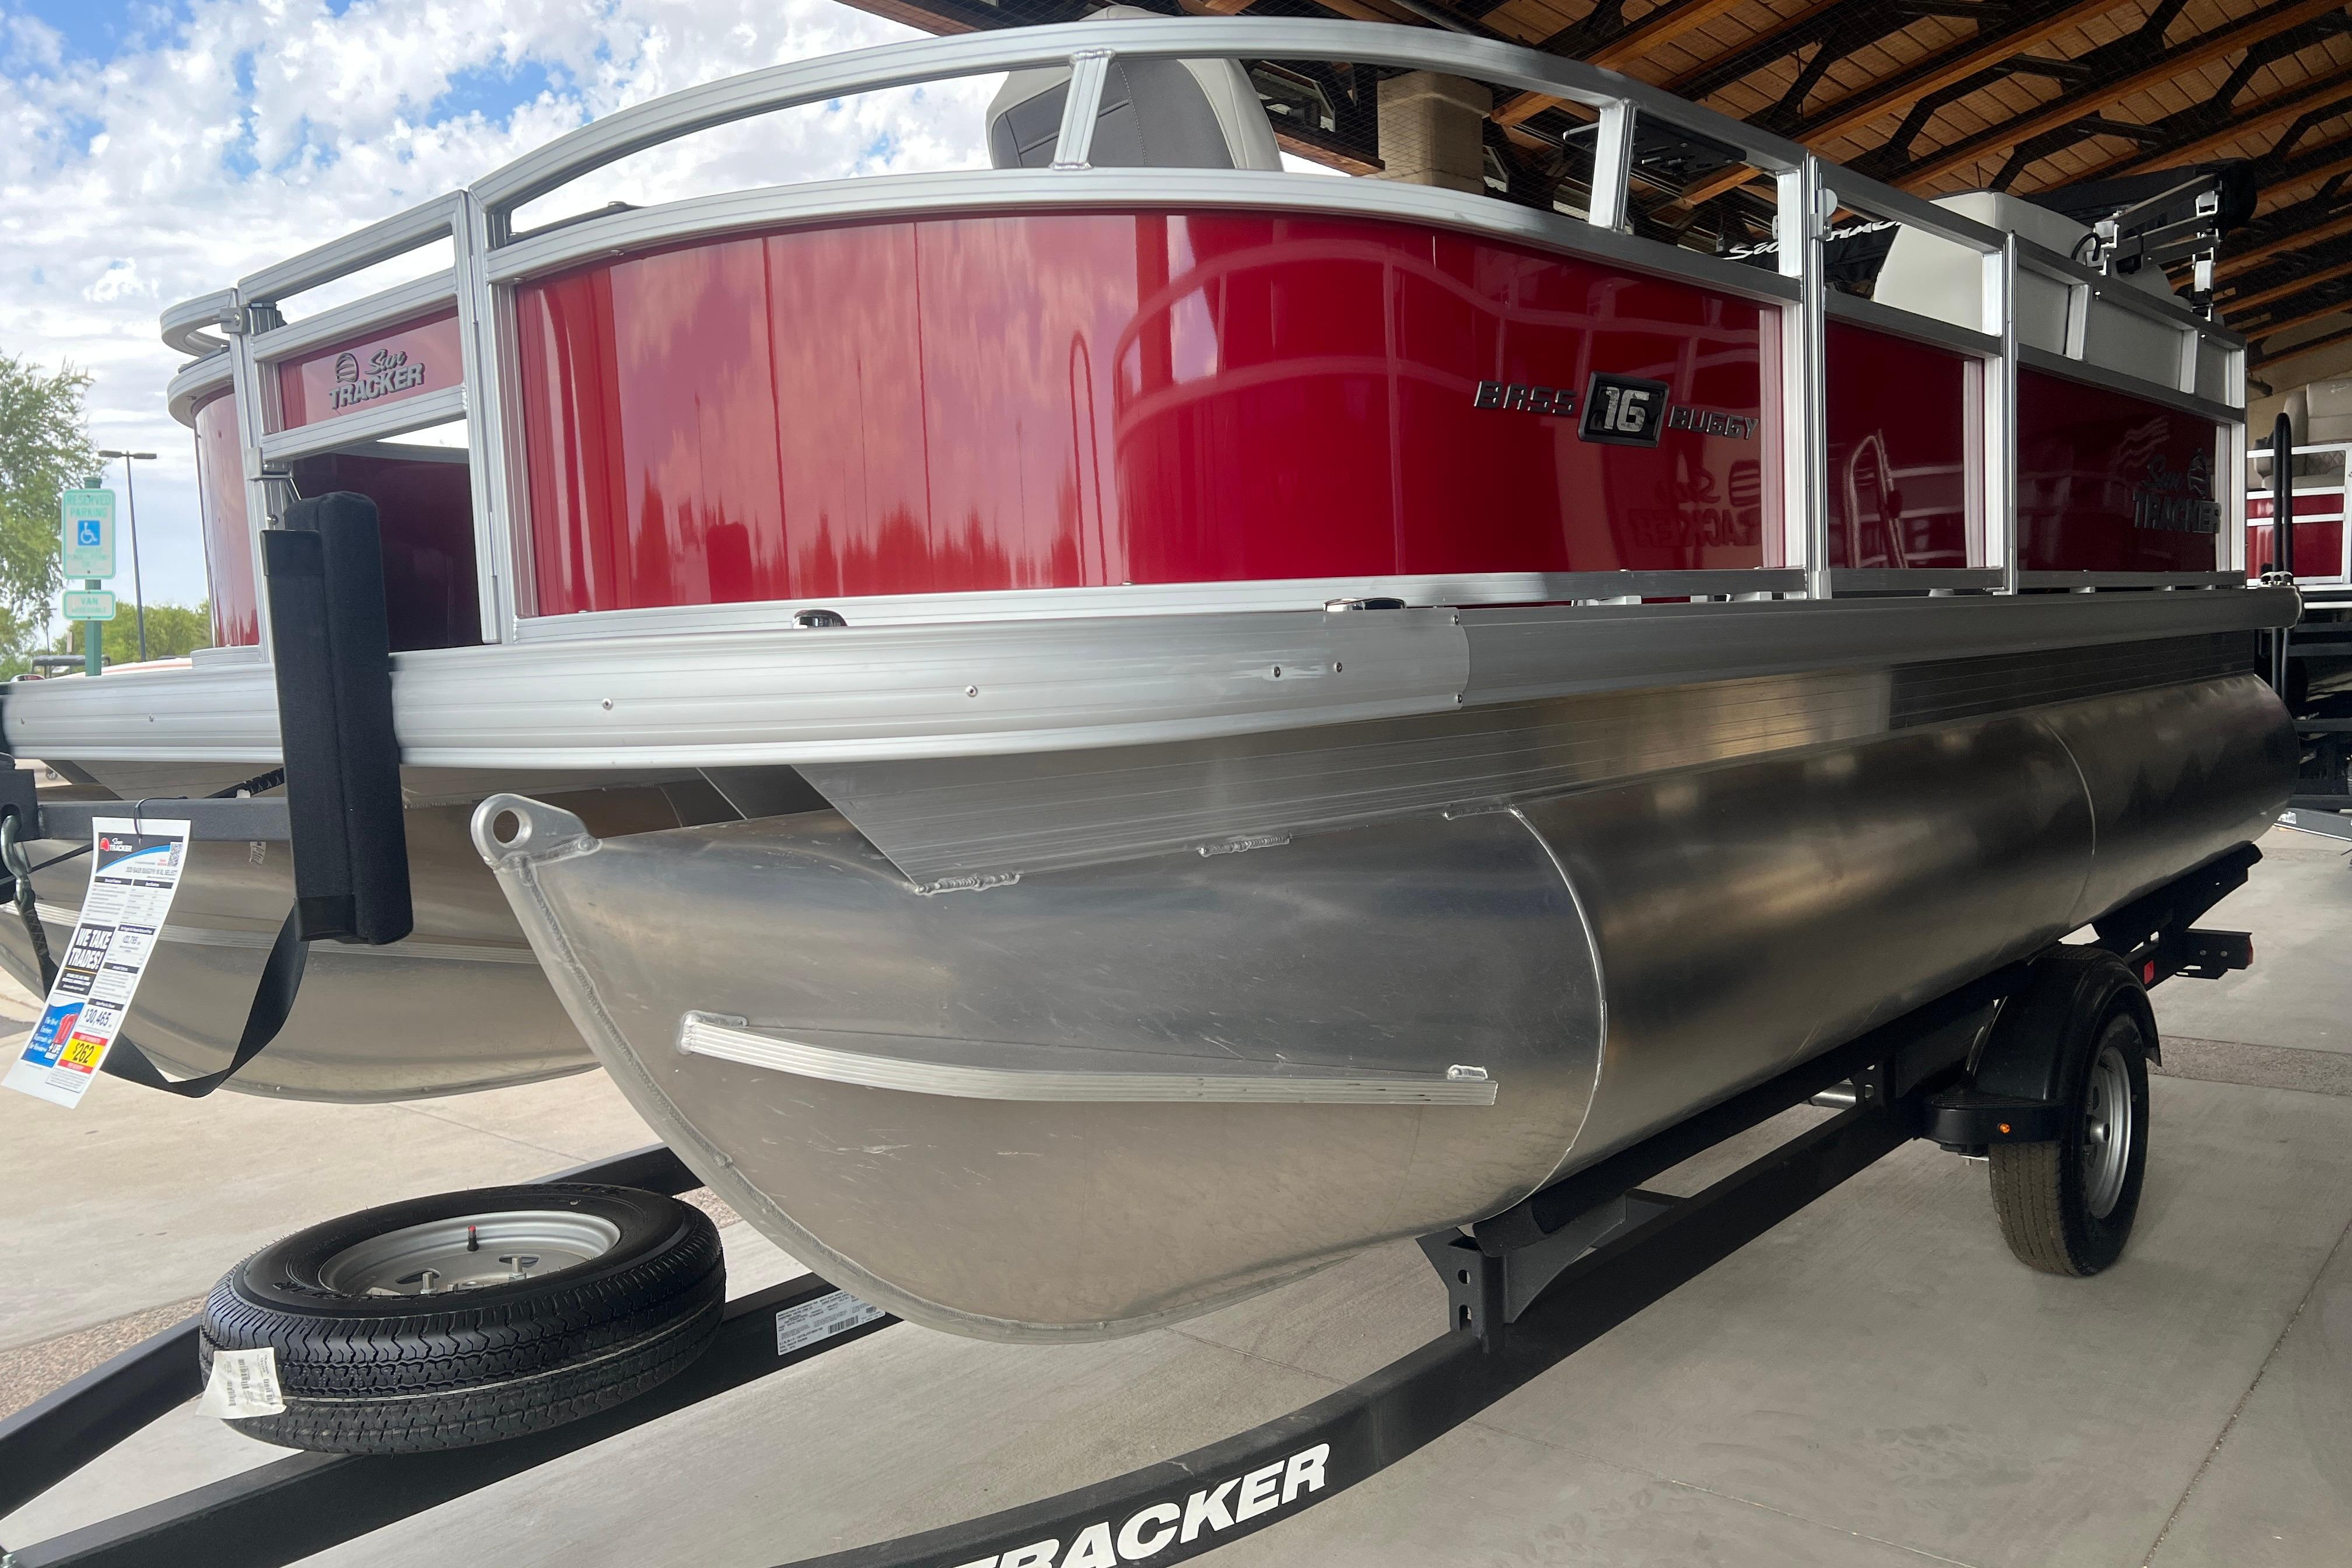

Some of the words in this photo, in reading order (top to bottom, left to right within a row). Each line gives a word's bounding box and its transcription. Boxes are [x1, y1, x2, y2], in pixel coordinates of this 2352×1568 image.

[365, 348, 408, 375] Sun
[329, 362, 425, 410] TRACKER
[1474, 380, 1577, 416] BASS
[1602, 385, 1650, 432] 16
[1668, 405, 1759, 440] BUGGY
[67, 494, 111, 505] RESERVED
[70, 508, 107, 518] PARKING
[2133, 492, 2222, 534] TRACKER
[80, 597, 99, 606] VAN
[75, 928, 93, 947] WE
[88, 929, 113, 950] TAKE
[68, 947, 105, 970] TRADES!
[72, 1042, 95, 1064] $262
[952, 1443, 1332, 1568] ACKER
